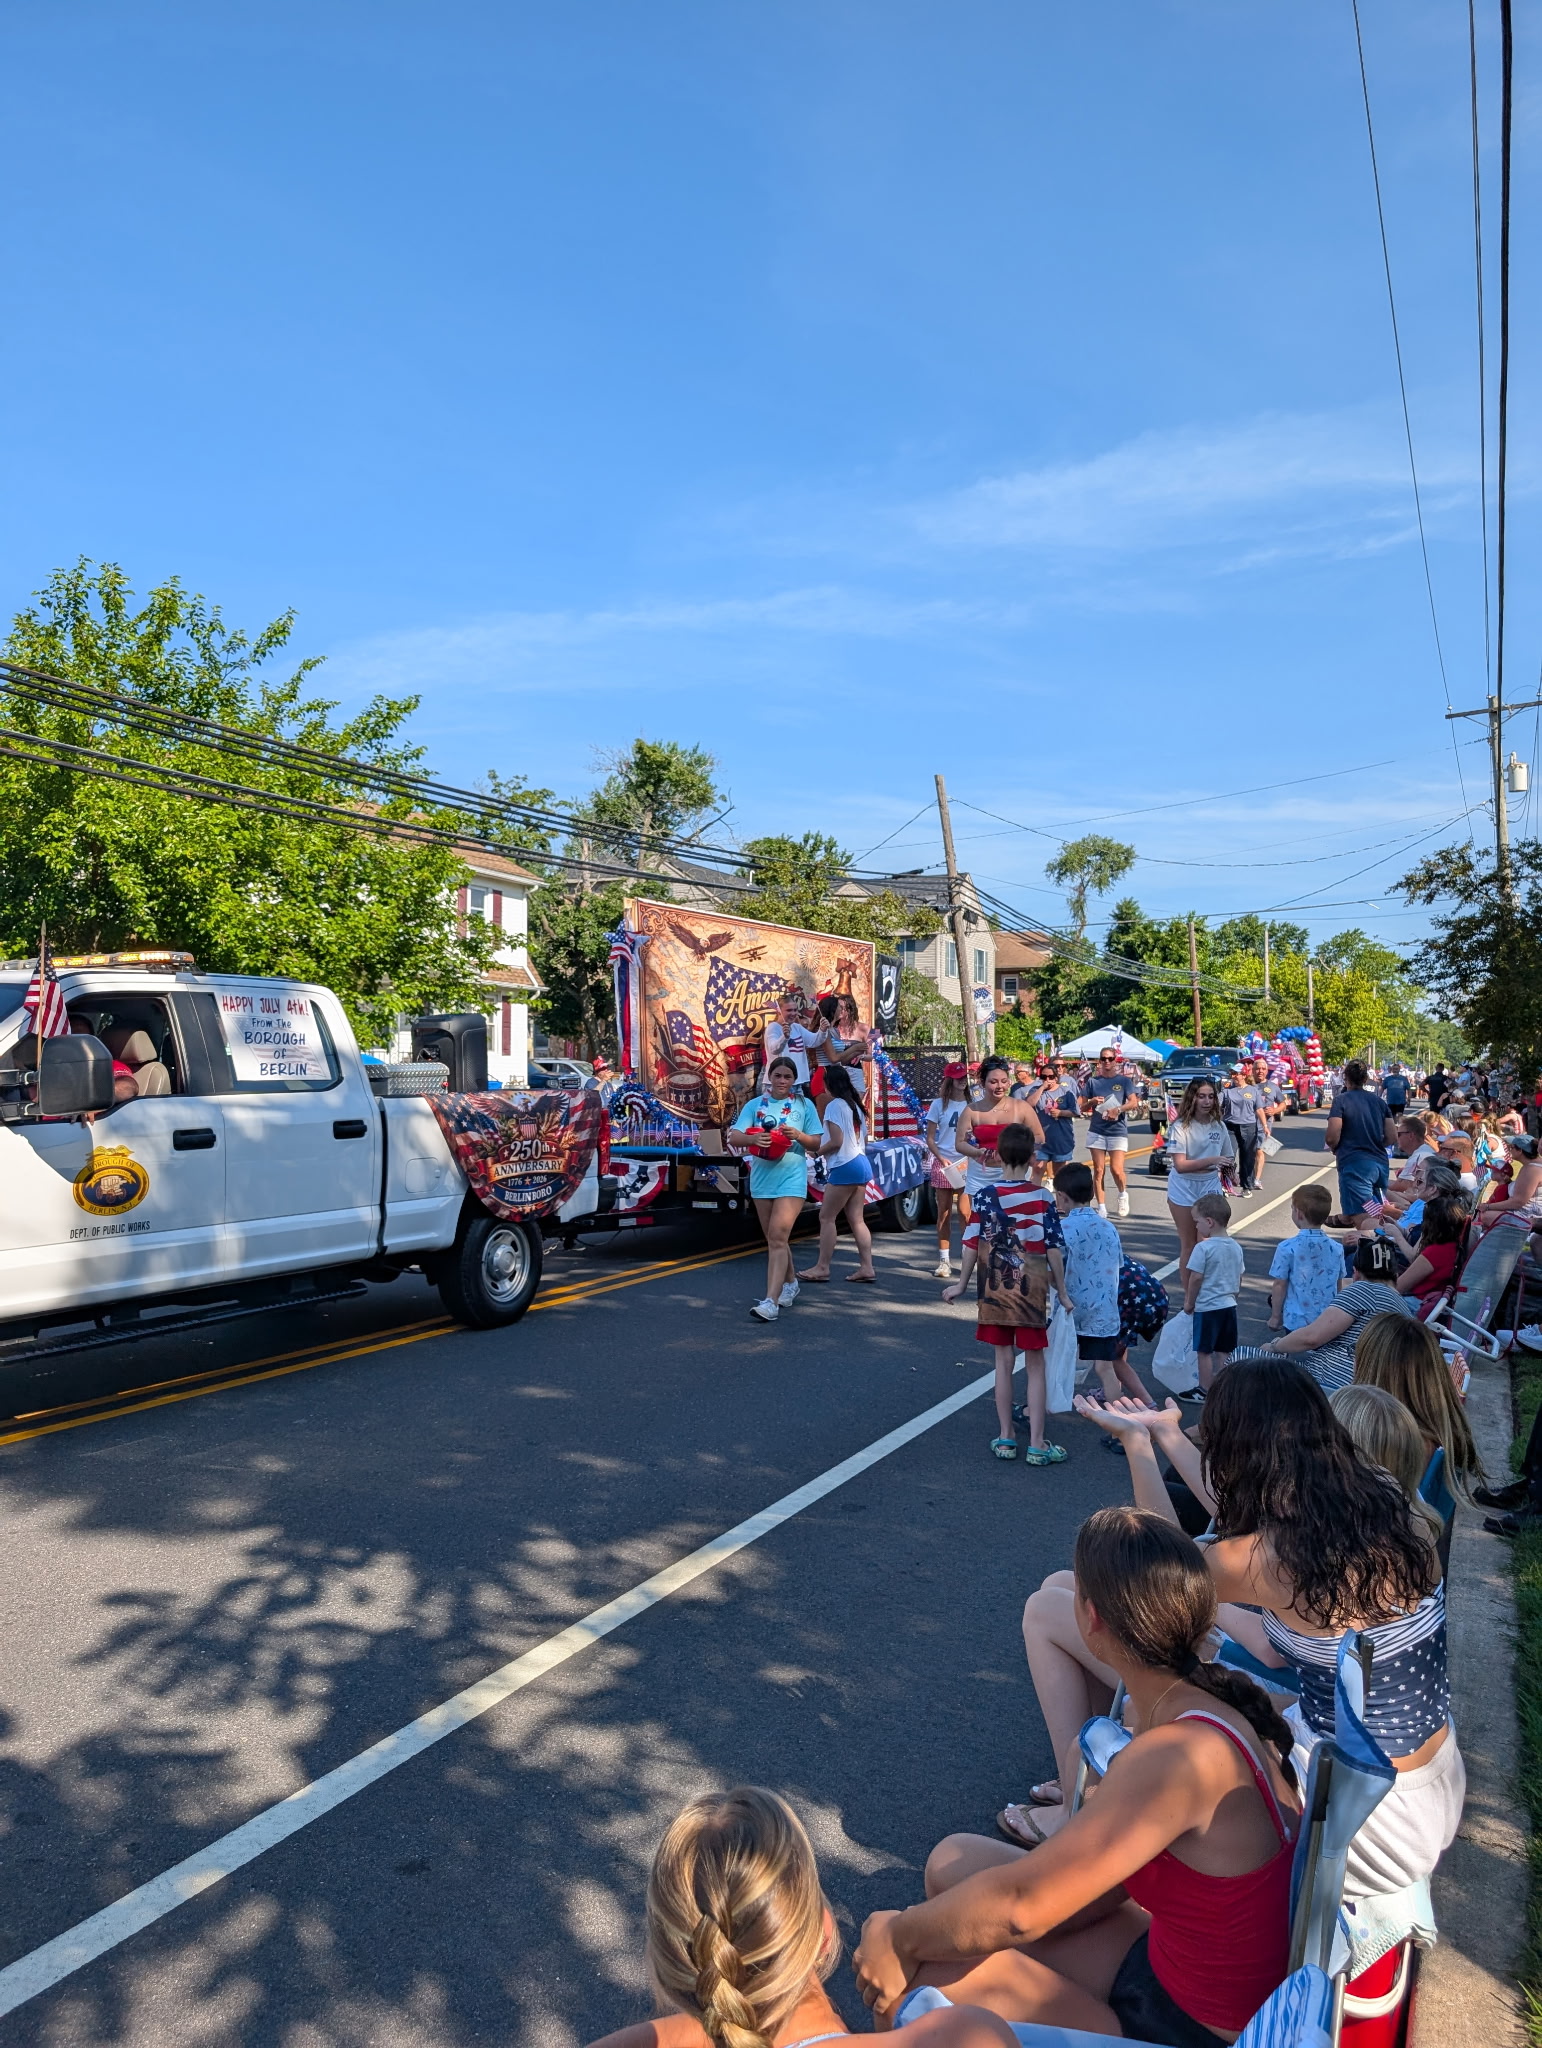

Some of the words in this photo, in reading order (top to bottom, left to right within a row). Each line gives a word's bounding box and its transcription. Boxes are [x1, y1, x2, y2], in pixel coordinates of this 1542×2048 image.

[222, 995, 254, 1013] HAPPY
[260, 996, 281, 1014] JULY
[287, 999, 310, 1016] 4th!
[252, 1017, 273, 1028] From
[276, 1018, 292, 1029] The
[244, 1031, 306, 1046] BOROUGH
[273, 1048, 287, 1059] of
[740, 1051, 762, 1064] UNITE
[260, 1062, 308, 1076] BERLIN
[509, 1138, 551, 1162] 250th
[88, 1159, 124, 1172] BOROUGH
[125, 1161, 136, 1169] OF
[494, 1160, 564, 1177] ANNIVERSARY
[873, 1144, 918, 1185] 1776
[507, 1177, 523, 1187] 1776
[532, 1174, 548, 1185] 2026
[69, 1227, 89, 1240] DEPT.
[91, 1226, 101, 1236] OF
[102, 1223, 126, 1235] PUBLIC
[127, 1220, 151, 1233] WORKS
